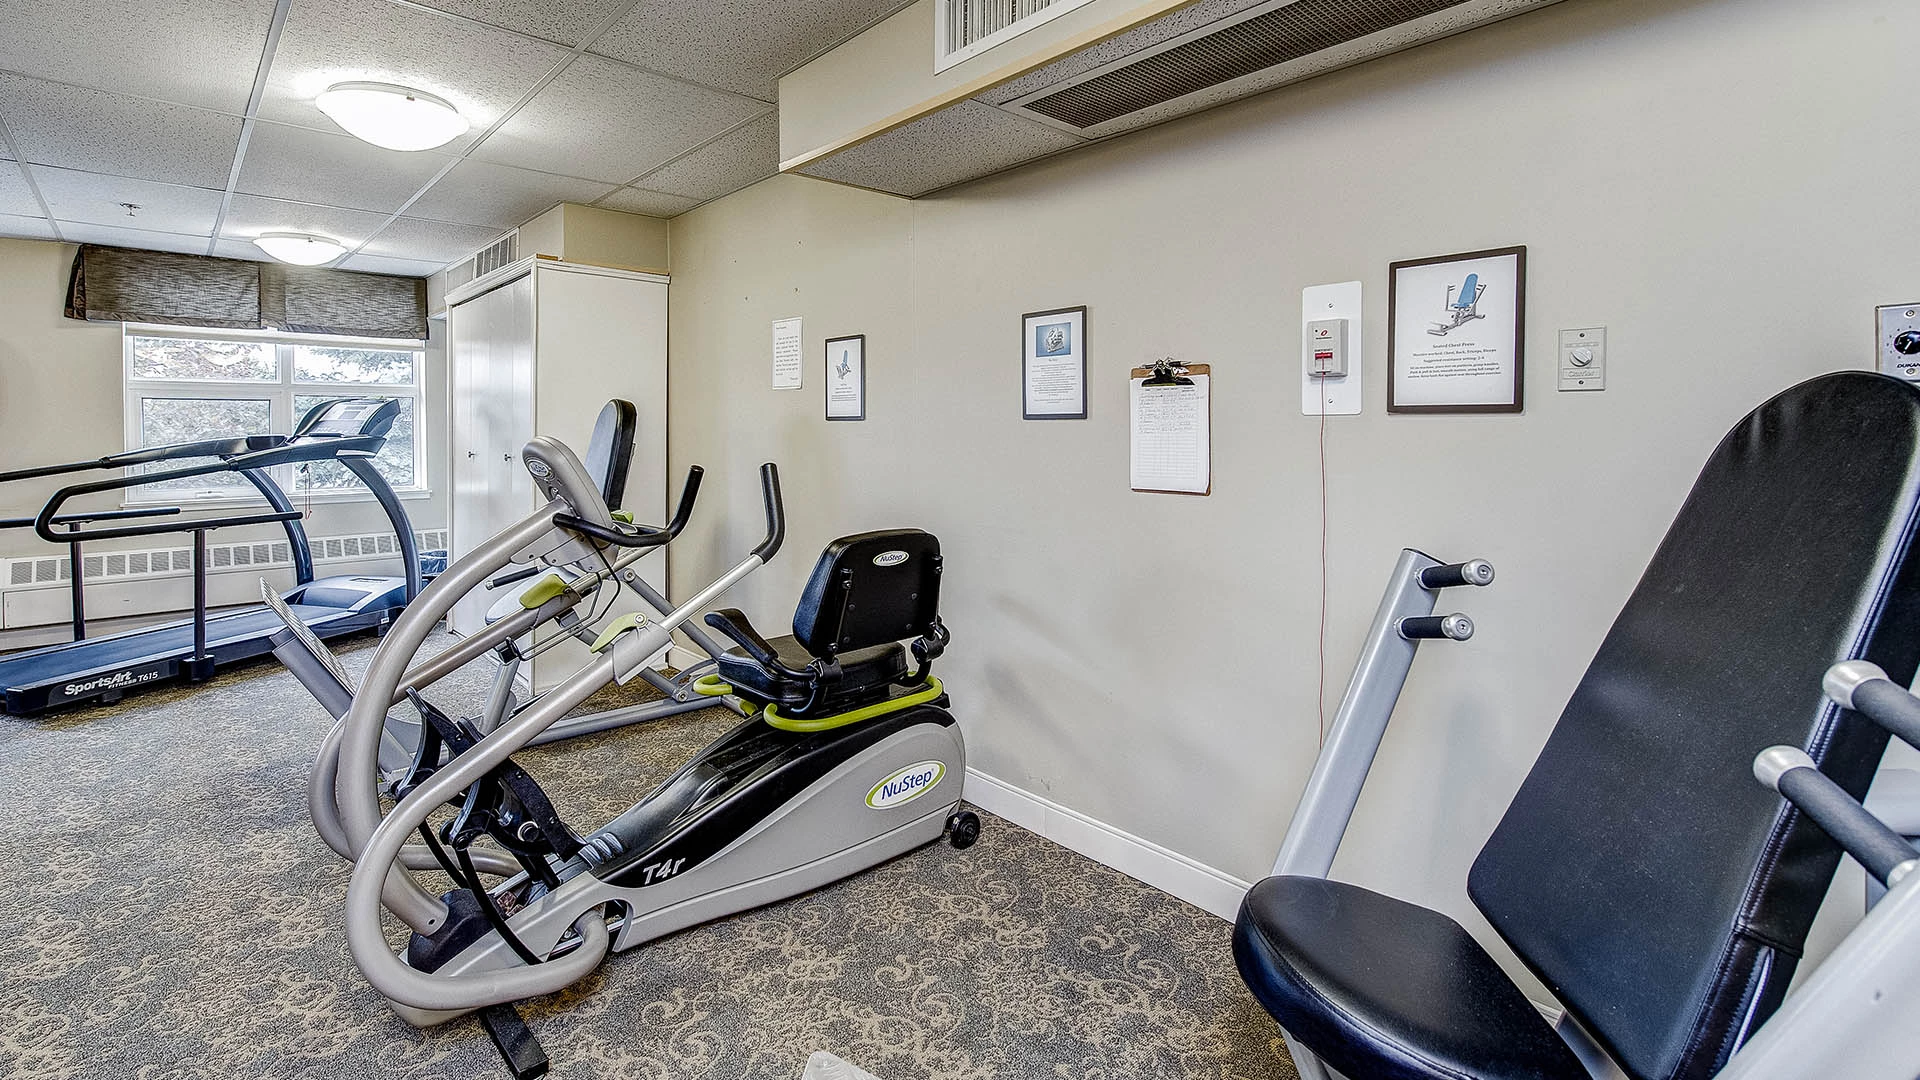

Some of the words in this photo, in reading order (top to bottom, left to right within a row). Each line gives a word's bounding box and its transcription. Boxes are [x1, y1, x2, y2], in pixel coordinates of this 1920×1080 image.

[64, 671, 132, 696] SportsArt
[137, 671, 159, 682] T615
[881, 770, 932, 800] NuStep
[643, 857, 686, 885] T4r
